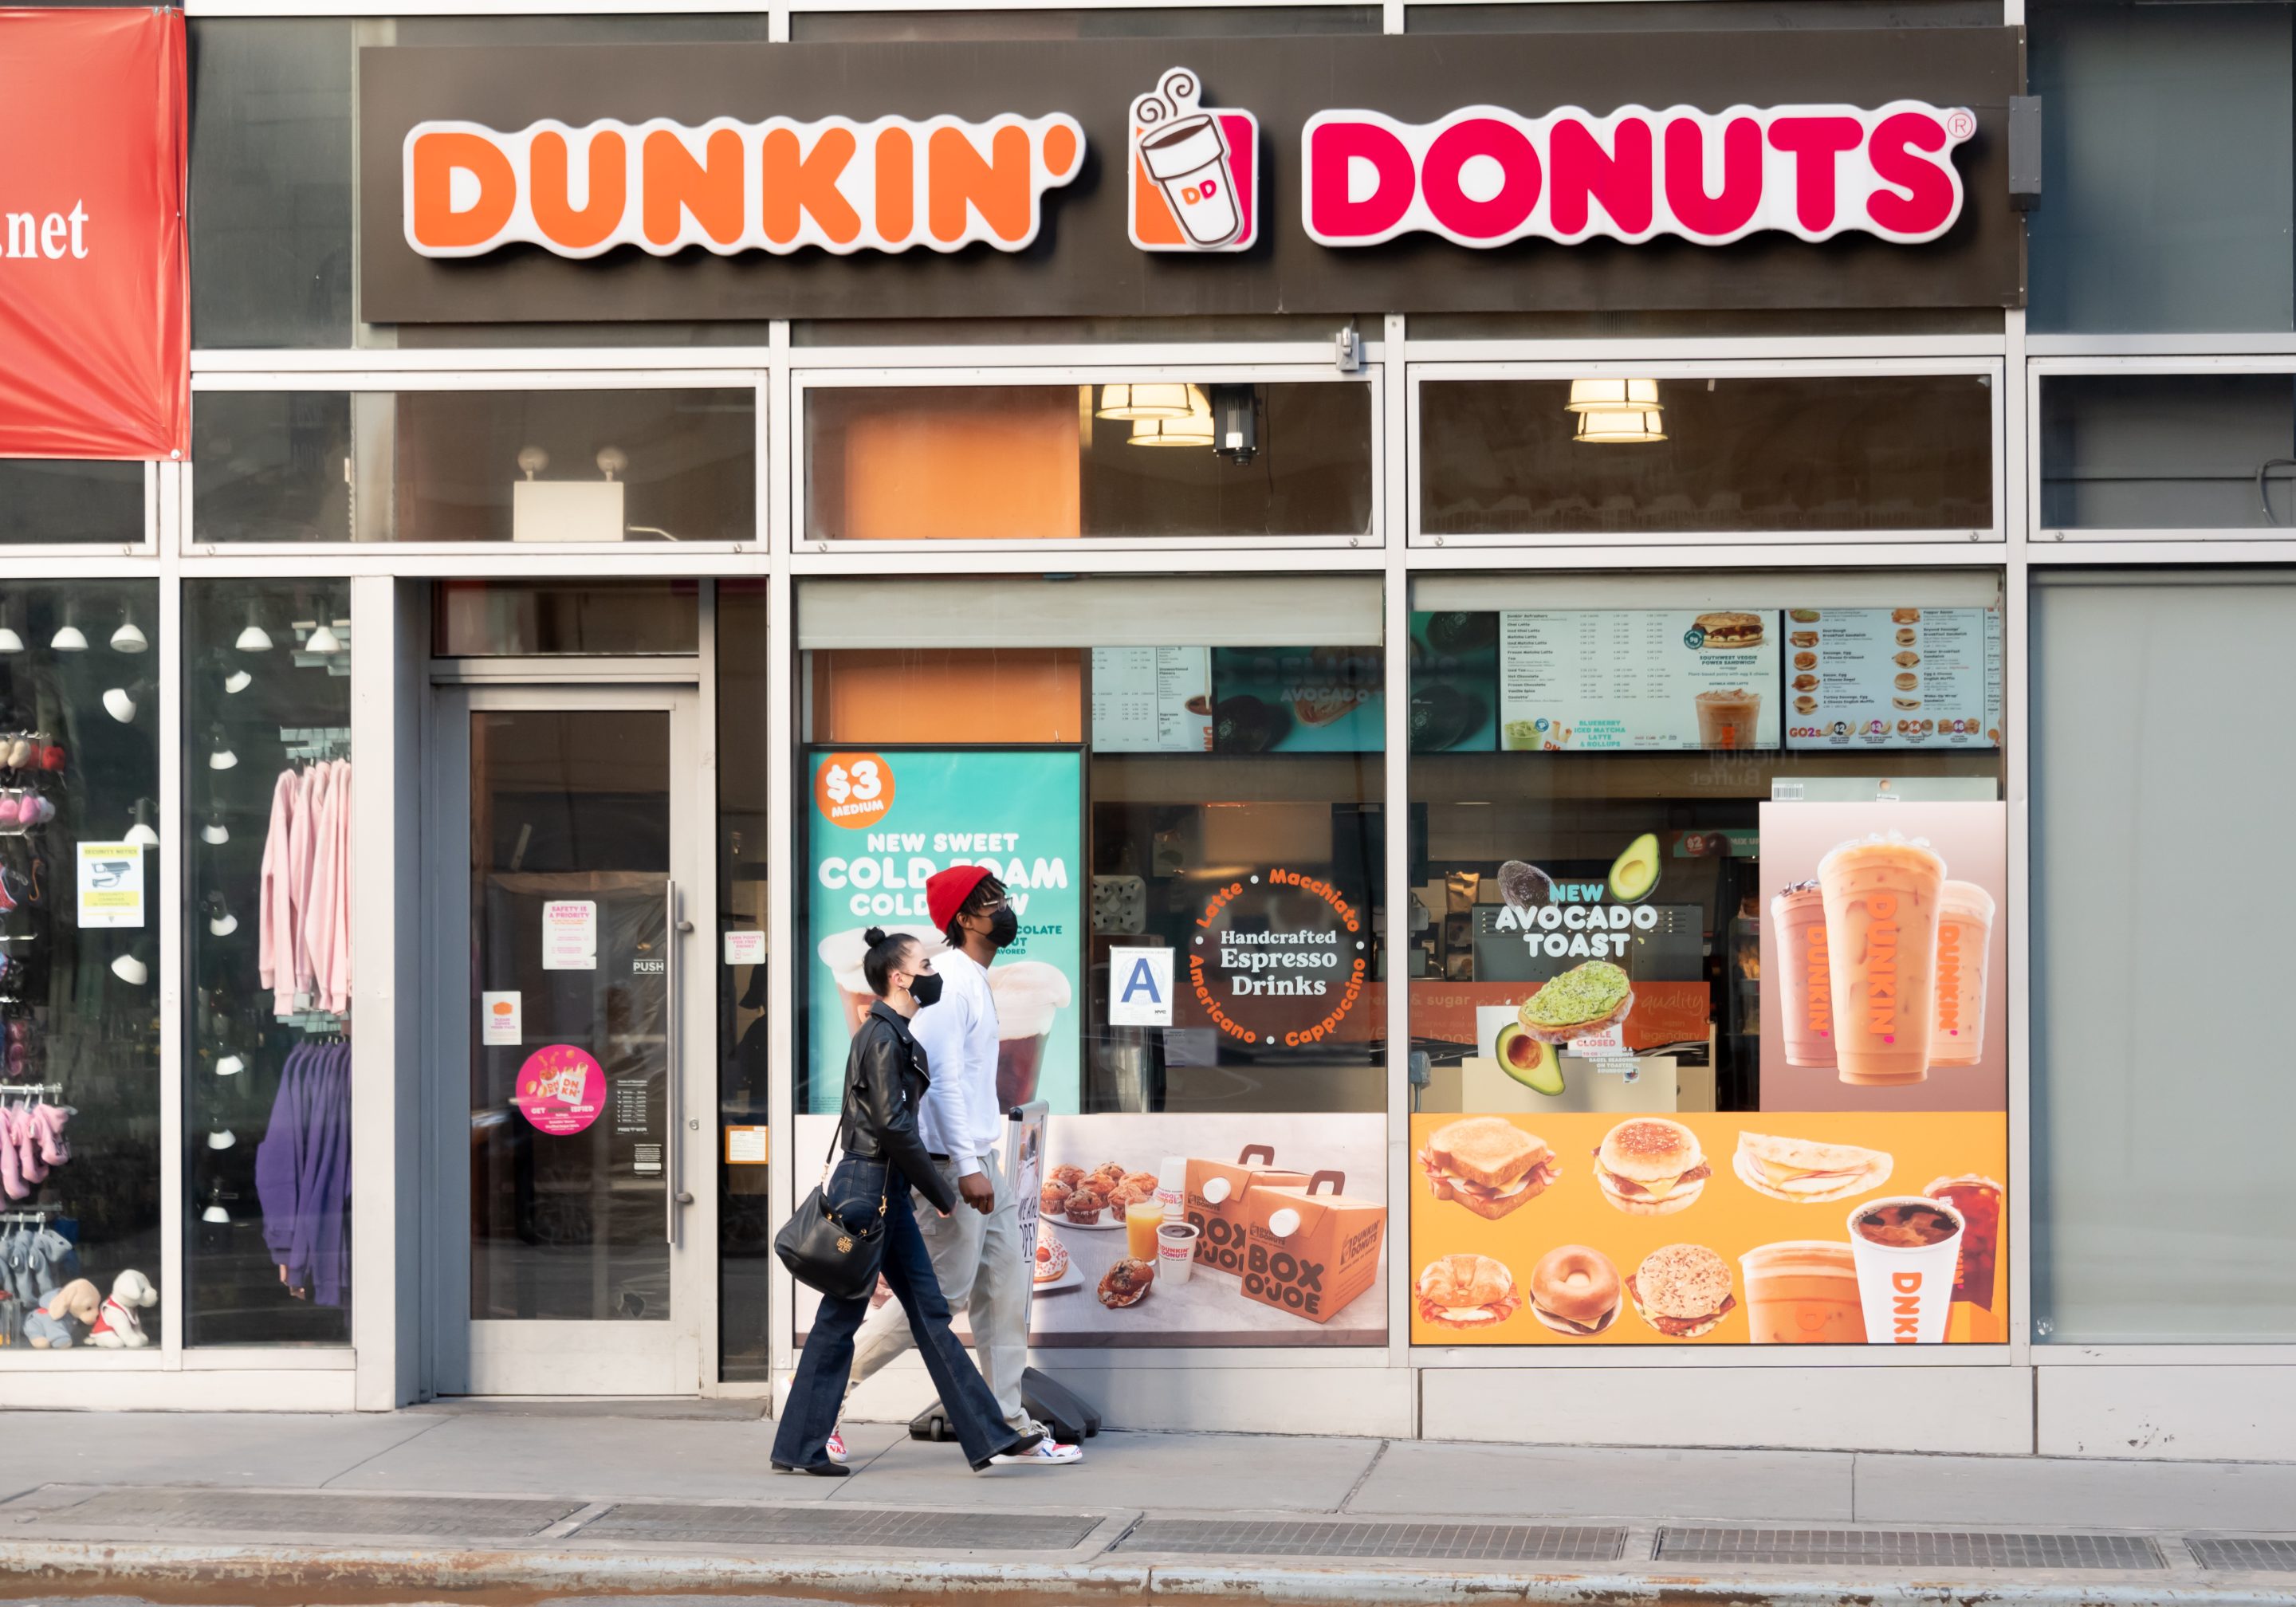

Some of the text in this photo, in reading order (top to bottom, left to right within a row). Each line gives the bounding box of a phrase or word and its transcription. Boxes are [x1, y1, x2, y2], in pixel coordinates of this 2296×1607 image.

[412, 124, 1077, 249] DUNKIN'
[1311, 112, 1954, 239] DONUTS
[1181, 179, 1218, 206] DD
[0, 198, 89, 260] net
[1280, 688, 1370, 702] AVOCADO
[826, 760, 882, 805] $3
[832, 800, 884, 818] MEDIUM
[867, 833, 1020, 853] NEW SWEET
[818, 856, 937, 890] COLD
[1196, 882, 1244, 929] Latte
[1269, 869, 1359, 933] Macchiato
[1549, 884, 1605, 902] NEW
[1495, 904, 1658, 930] AVOCADO
[1221, 930, 1338, 945] Handcrafted
[1523, 933, 1630, 958] TOAST
[632, 961, 664, 972] PUSH
[1221, 948, 1338, 973] Espresso
[1121, 957, 1162, 1003] A
[1232, 976, 1327, 996] Drinks
[1189, 954, 1256, 1044] Americano
[1285, 958, 1366, 1047] Cappuccino
[1426, 995, 1471, 1008] sugar
[1640, 989, 1704, 1016] quality
[1640, 1031, 1700, 1043] legendary
[1351, 1219, 1380, 1246] DUNKIN'
[1351, 1232, 1378, 1258] DONUTS
[1160, 1244, 1189, 1253] DUNKIN'
[1248, 1244, 1324, 1292] BOX
[1244, 1273, 1321, 1315] O'JOE
